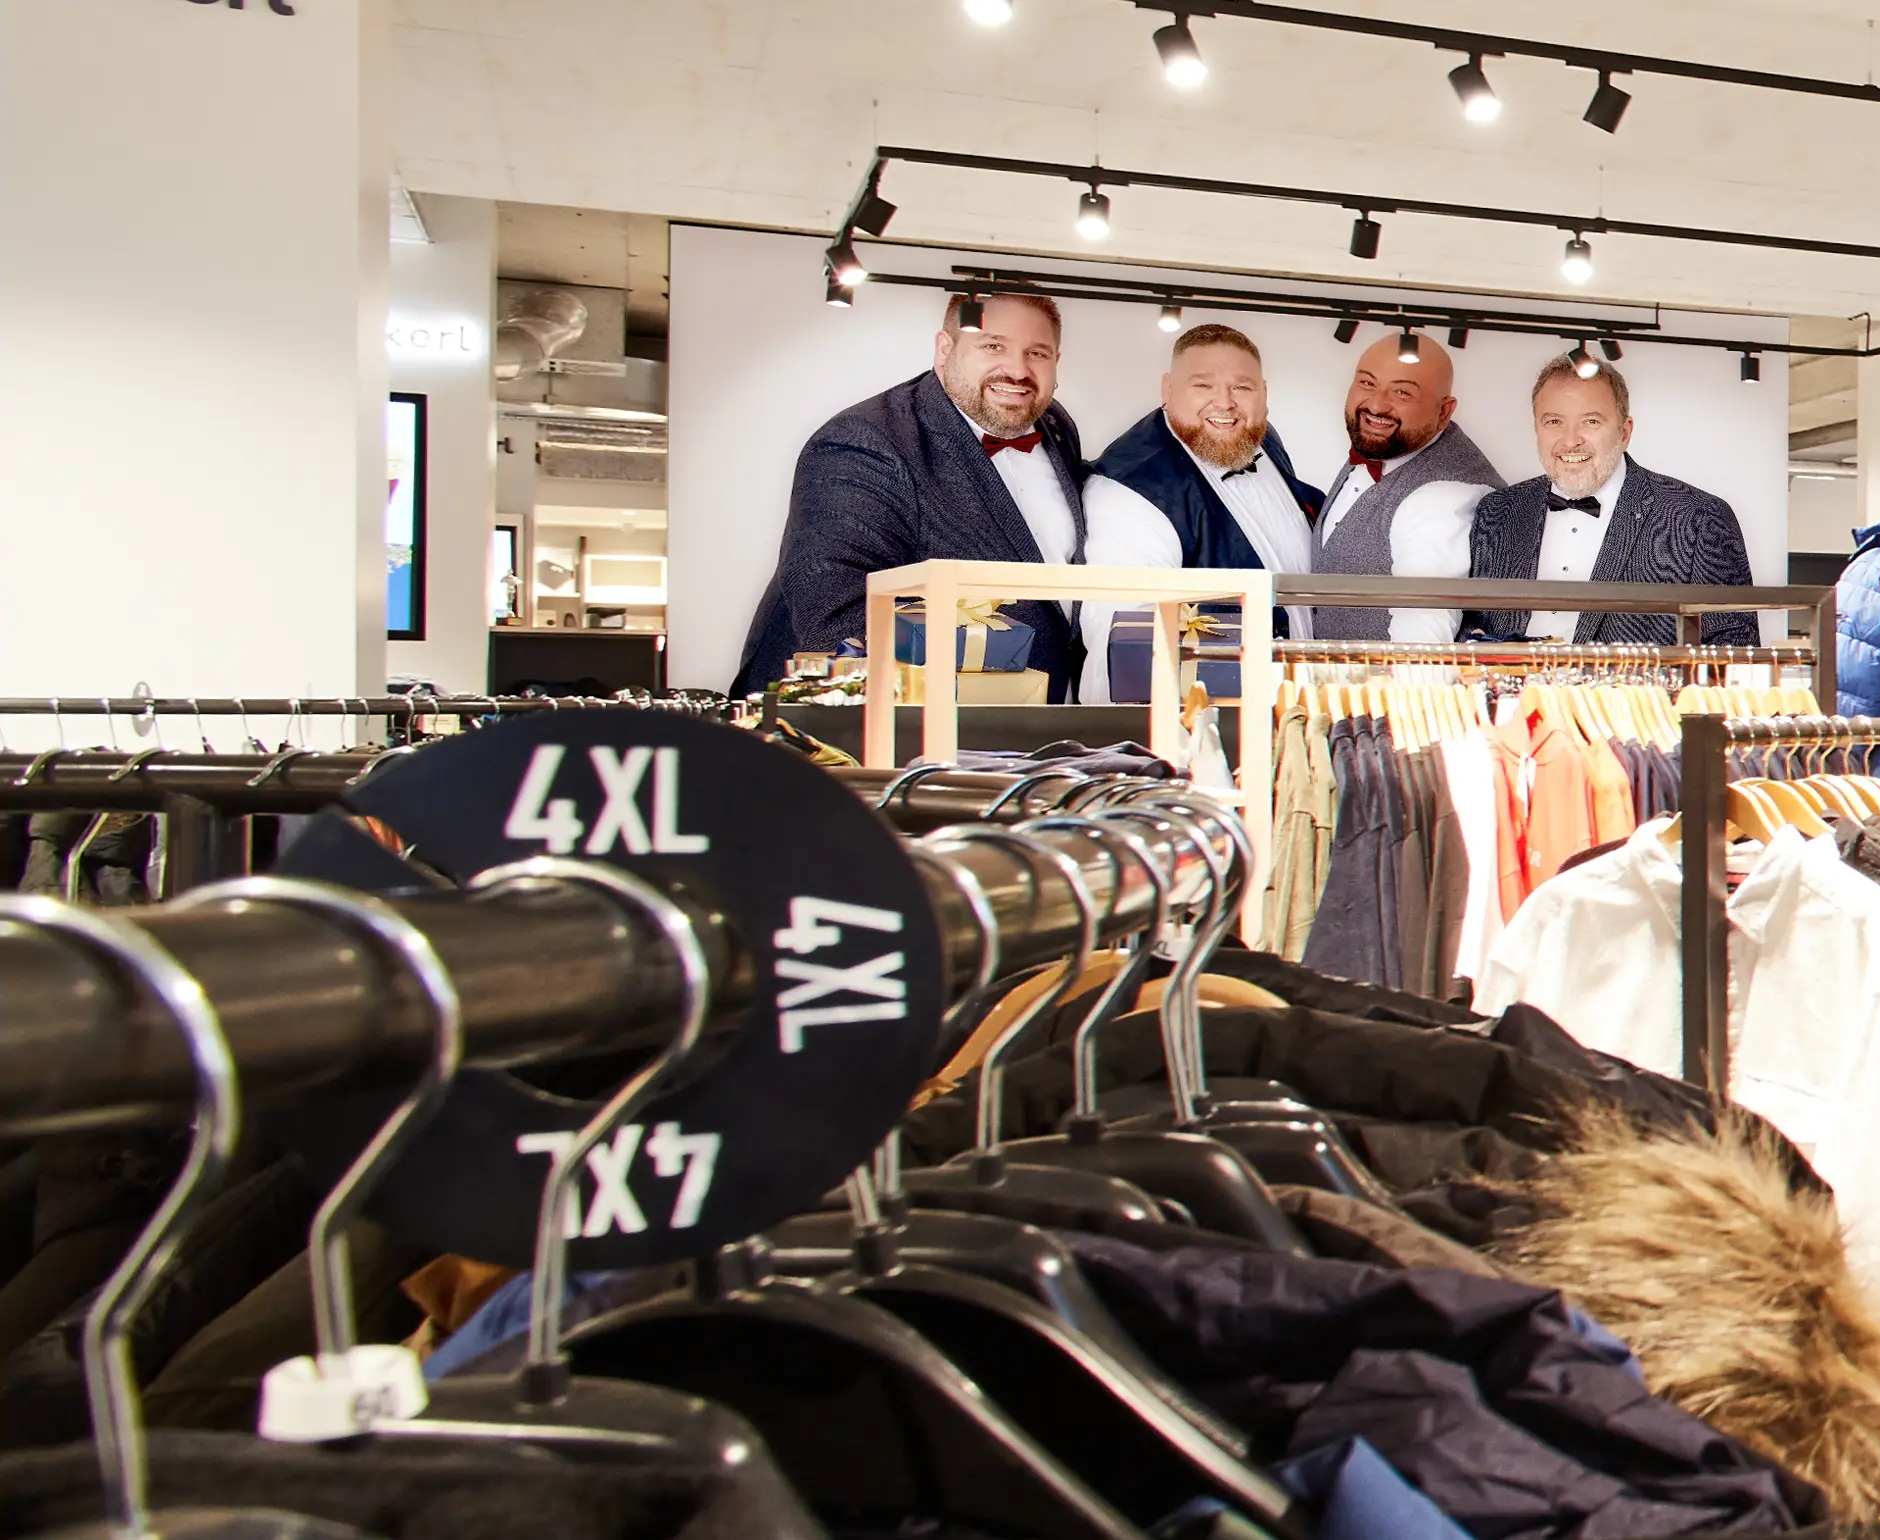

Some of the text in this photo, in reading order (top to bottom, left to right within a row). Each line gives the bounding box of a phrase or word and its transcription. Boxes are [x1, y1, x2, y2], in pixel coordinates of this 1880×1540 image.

[504, 743, 710, 855] 4XL
[773, 896, 908, 1054] 4XL
[515, 1121, 722, 1240] 4XL
